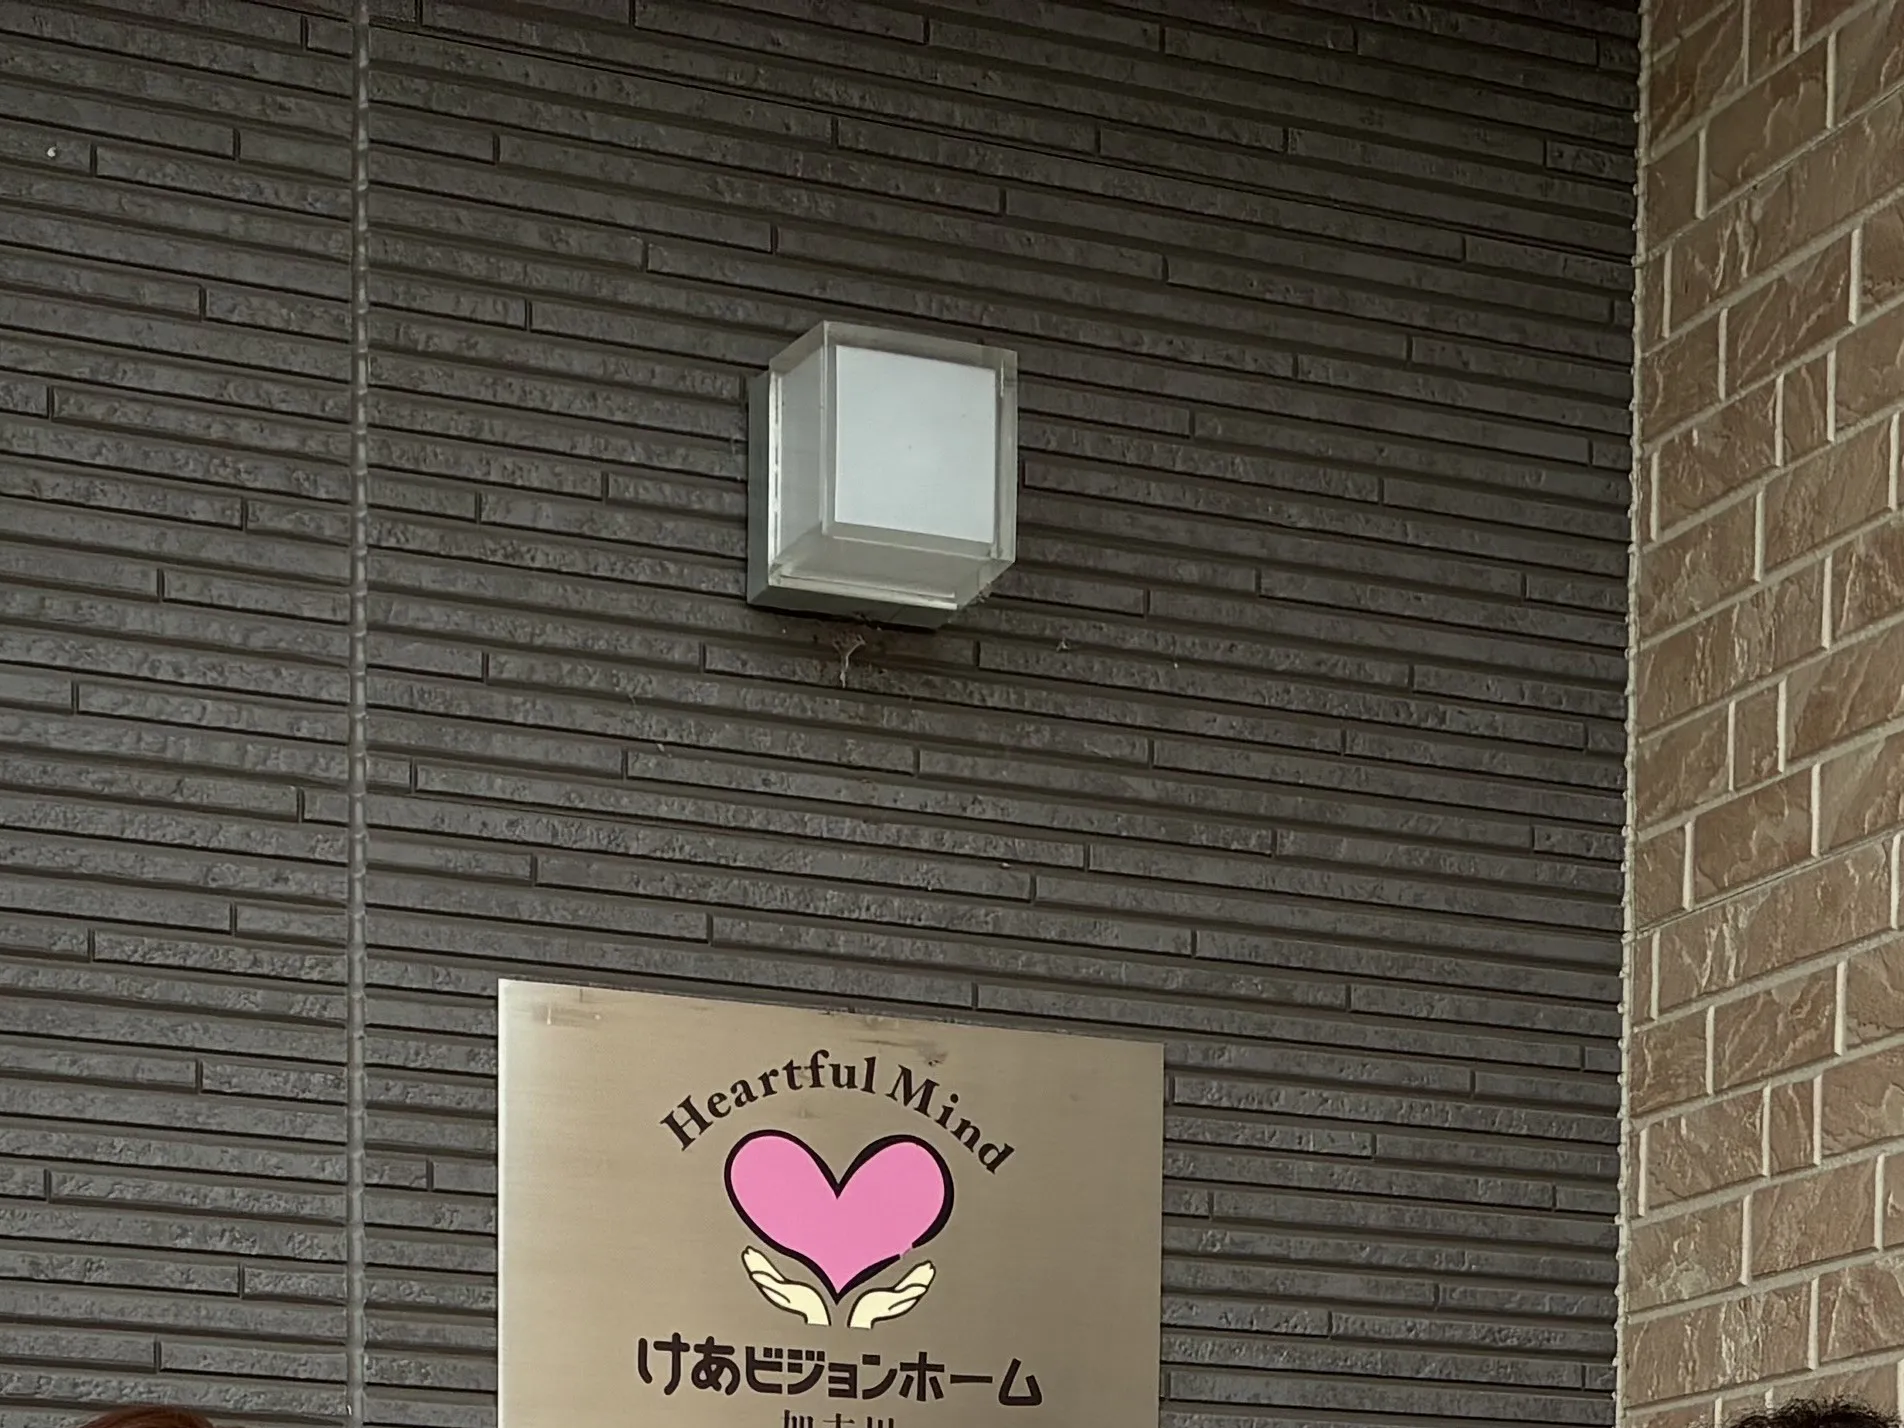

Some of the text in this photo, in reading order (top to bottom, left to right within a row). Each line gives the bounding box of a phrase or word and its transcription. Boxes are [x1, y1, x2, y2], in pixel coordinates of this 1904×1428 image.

[659, 1049, 1016, 1175] Heartful Mind
[637, 1332, 1043, 1407] けあビジョンホーム
